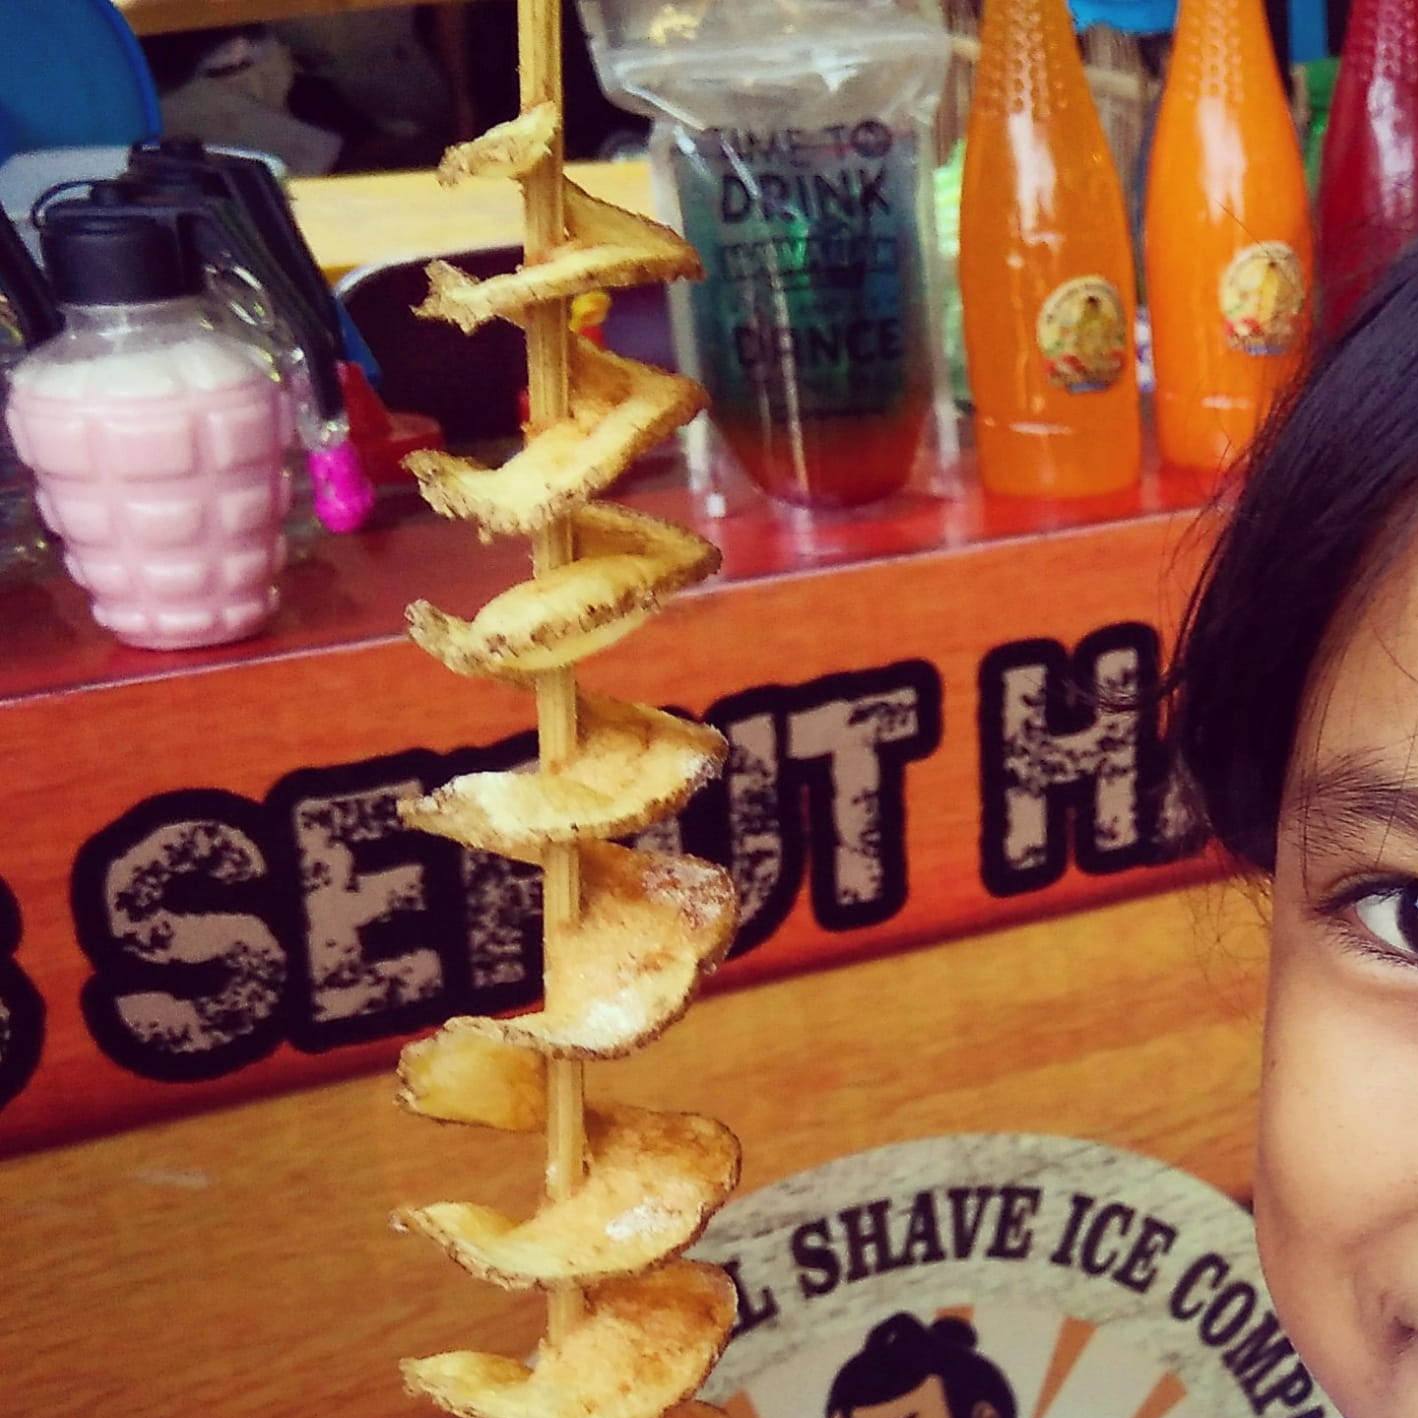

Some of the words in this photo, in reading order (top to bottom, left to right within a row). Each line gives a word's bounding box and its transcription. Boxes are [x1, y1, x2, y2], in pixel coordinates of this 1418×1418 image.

[820, 119, 894, 160] TO
[720, 166, 892, 226] DRINK
[791, 1186, 1043, 1300] SHAVE
[1051, 1192, 1180, 1295] ICE
